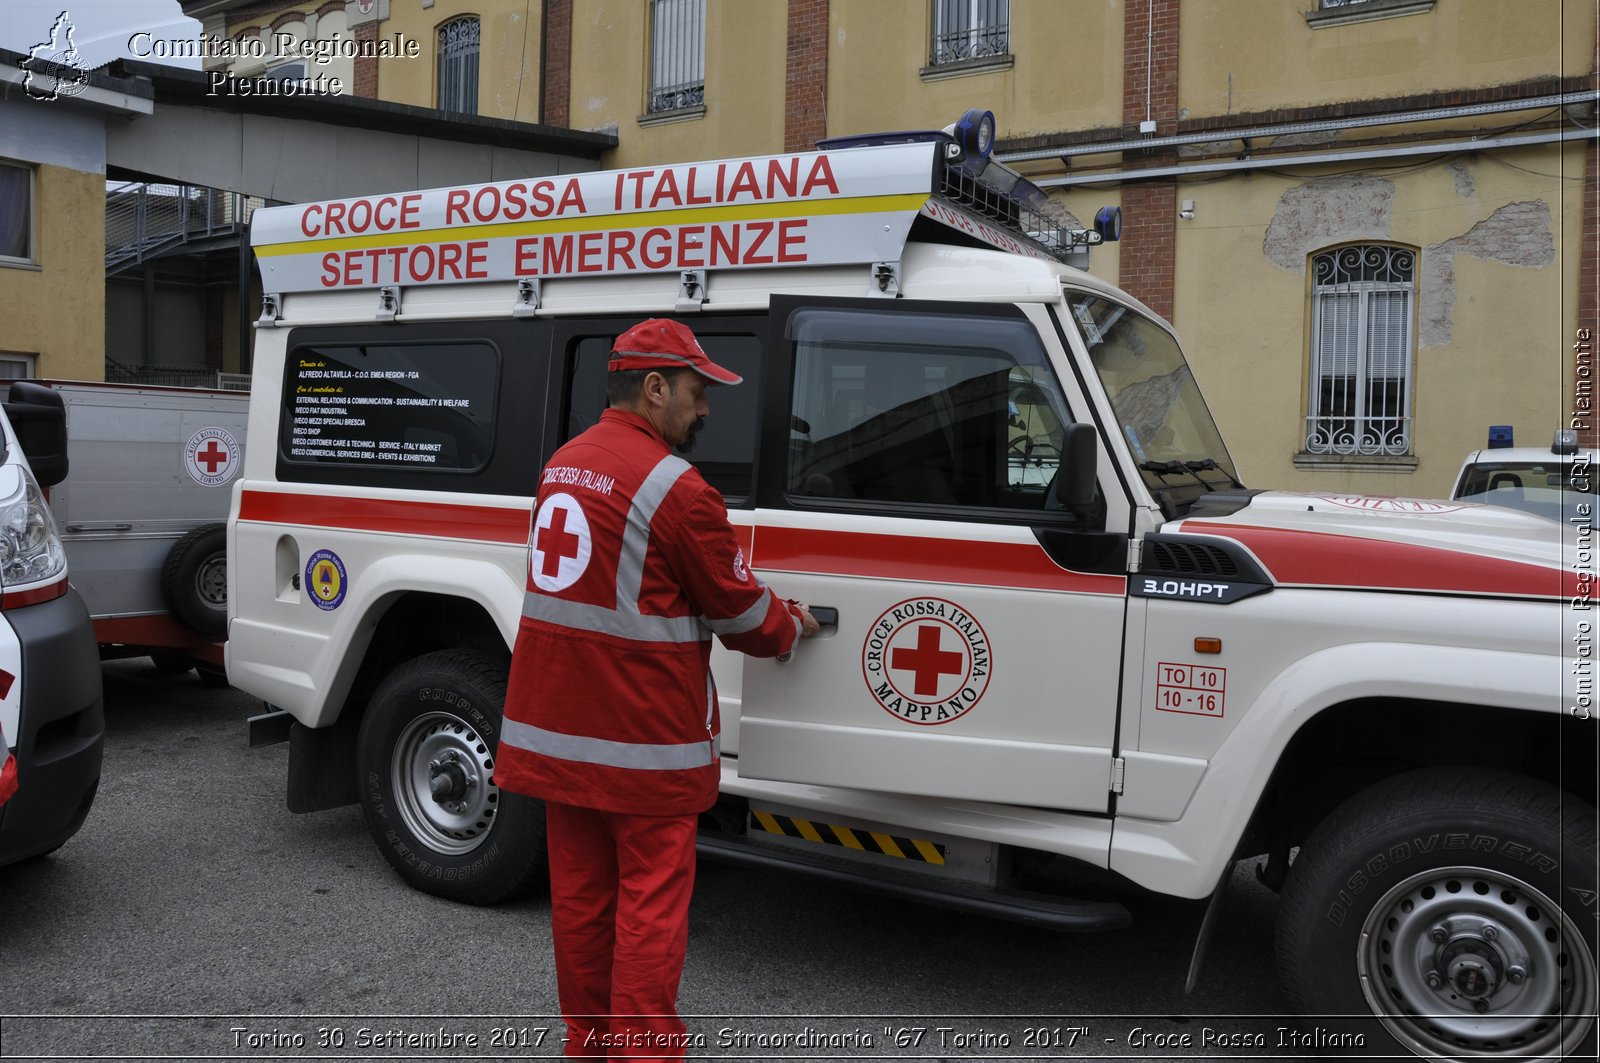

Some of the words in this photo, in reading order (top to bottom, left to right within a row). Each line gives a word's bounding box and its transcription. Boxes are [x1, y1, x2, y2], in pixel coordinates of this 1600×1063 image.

[301, 194, 422, 237] CROCE
[446, 179, 587, 224] ROSSA
[614, 155, 839, 211] ITALIANA
[320, 241, 489, 287] SETTORE
[515, 219, 808, 276] EMERGENZE
[299, 370, 323, 378] ALFREDO
[323, 370, 351, 378] ALTAVILLA
[320, 407, 348, 415] INDUSTRIAL
[352, 397, 393, 405] COMMUNICATION
[396, 398, 437, 406] SUSTAINABILITY
[443, 399, 469, 407] WELFARE
[188, 437, 200, 459] CROCE
[200, 430, 220, 438] ROSSA
[220, 431, 237, 459] ITALIANA
[305, 449, 336, 457] COMMERCIAL
[336, 450, 360, 458] SERVICES
[361, 451, 375, 459] EMEA
[378, 452, 398, 460] EVENTS
[403, 453, 436, 462] EXHIBITIONS
[351, 440, 375, 448] TECHNICA
[378, 441, 401, 449] SERVICE
[403, 442, 419, 450] ITALY
[419, 443, 441, 451] MARKET
[200, 474, 224, 484] TORINO
[559, 467, 580, 485] ROSSA
[577, 469, 615, 496] ITALIANA
[1143, 580, 1229, 598] 3.0HPT
[867, 619, 894, 674] CROCE
[892, 601, 946, 623] ROSSA
[949, 608, 988, 681] ITALIANA
[1164, 668, 1186, 684] TO
[1200, 672, 1217, 687] 10
[420, 688, 493, 735] COOPER
[874, 681, 977, 721] MAPPANO
[1163, 690, 1181, 708] 10
[1197, 695, 1216, 711] 16
[385, 829, 499, 880] DISCOVERER
[1327, 834, 1558, 928] DISCOVERER
